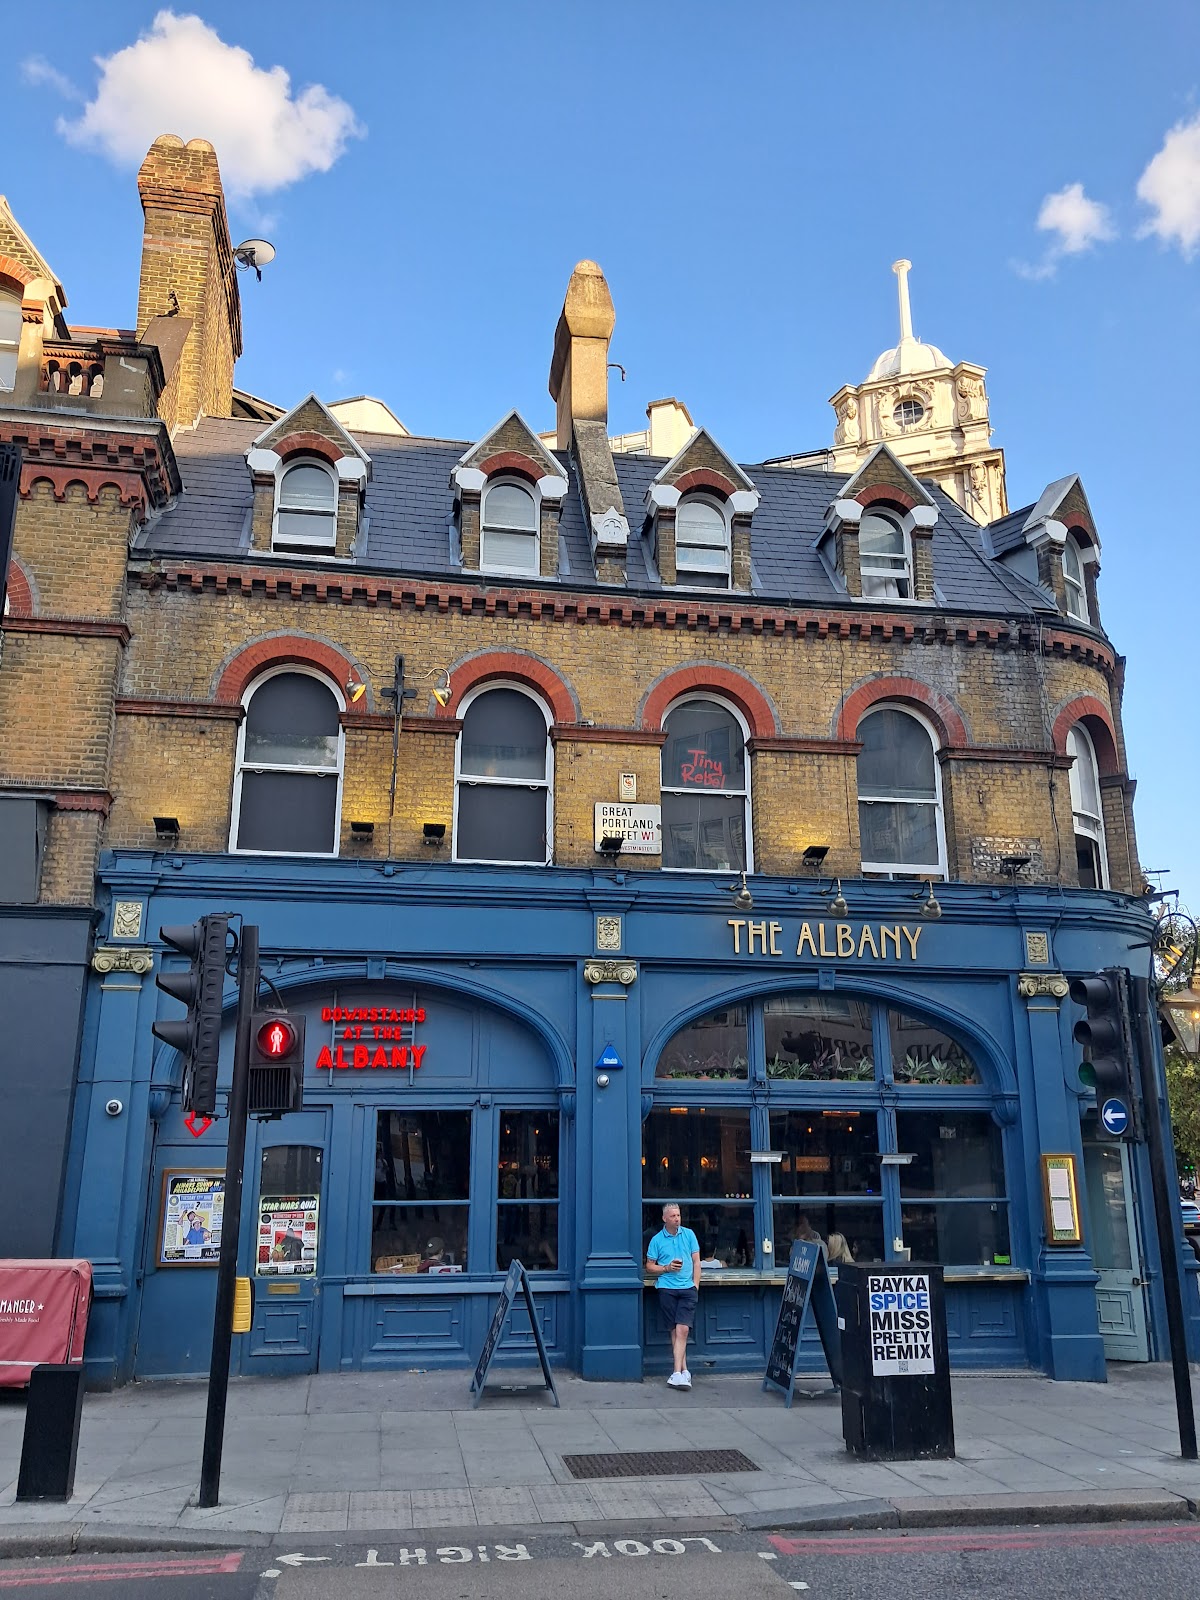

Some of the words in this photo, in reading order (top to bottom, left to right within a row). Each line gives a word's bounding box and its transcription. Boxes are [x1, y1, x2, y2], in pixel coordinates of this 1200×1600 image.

[687, 749, 723, 776] Tiny
[681, 763, 726, 789] Rebel
[602, 806, 633, 817] GREAT
[602, 818, 653, 829] PORTLAND
[602, 830, 638, 841] STREET
[641, 831, 654, 841] W1
[727, 919, 783, 956] THE
[796, 922, 922, 960] ALBANY
[321, 1006, 427, 1023] DOWNSTAIRS
[343, 1025, 363, 1040] AT
[372, 1025, 403, 1041] THE
[315, 1044, 427, 1069] ALBANY
[262, 1202, 279, 1211] STAR
[280, 1201, 300, 1210] WARS
[300, 1200, 316, 1209] QUIZ
[870, 1277, 928, 1292] BAYKA
[871, 1293, 928, 1310] SPICE
[871, 1310, 930, 1330] MISS
[872, 1331, 930, 1344] PRETTY
[873, 1344, 931, 1360] REMIX
[355, 1543, 533, 1567] RIGHT
[572, 1537, 723, 1559] LOOK
